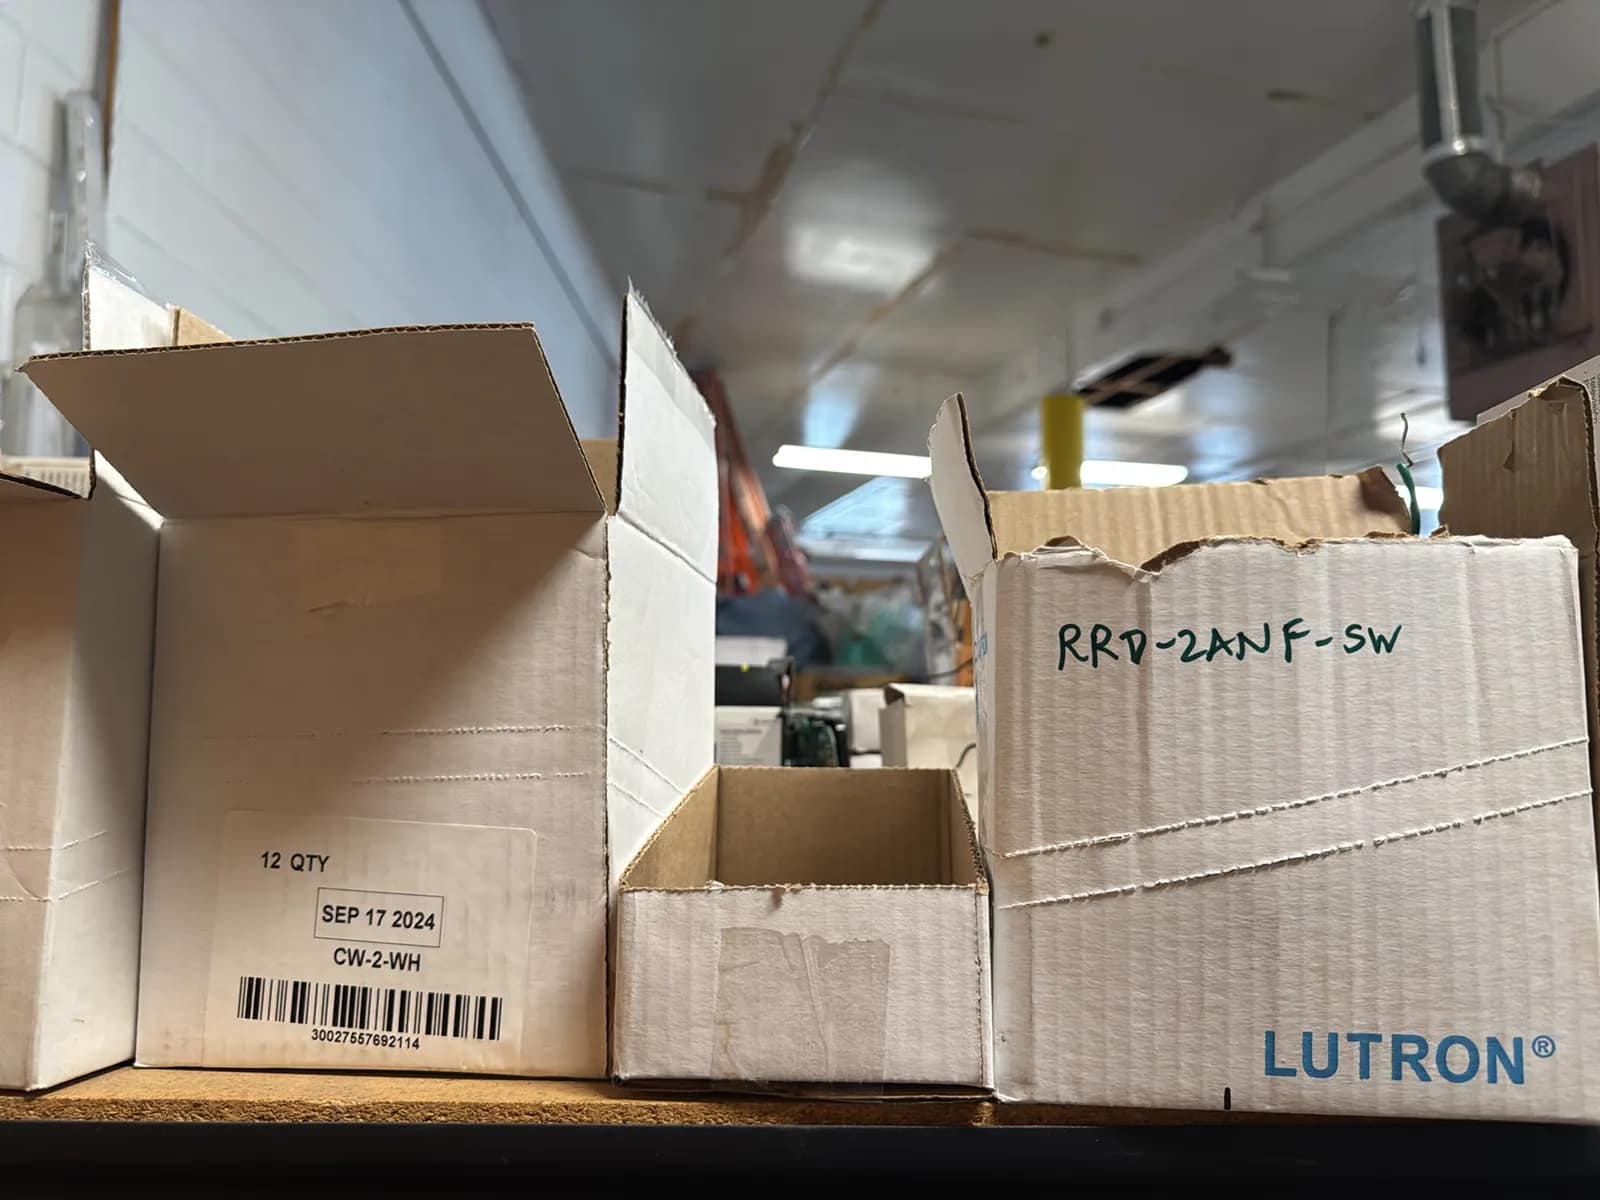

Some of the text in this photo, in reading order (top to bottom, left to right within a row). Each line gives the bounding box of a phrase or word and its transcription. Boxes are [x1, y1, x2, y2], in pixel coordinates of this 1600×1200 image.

[1058, 618, 1402, 671] RRD-2ANF-SW
[261, 851, 330, 872] 12 QTY
[322, 904, 436, 931] SEP 17 2024
[333, 947, 421, 971] CW-2-WH
[311, 1028, 420, 1050] 30027557692114
